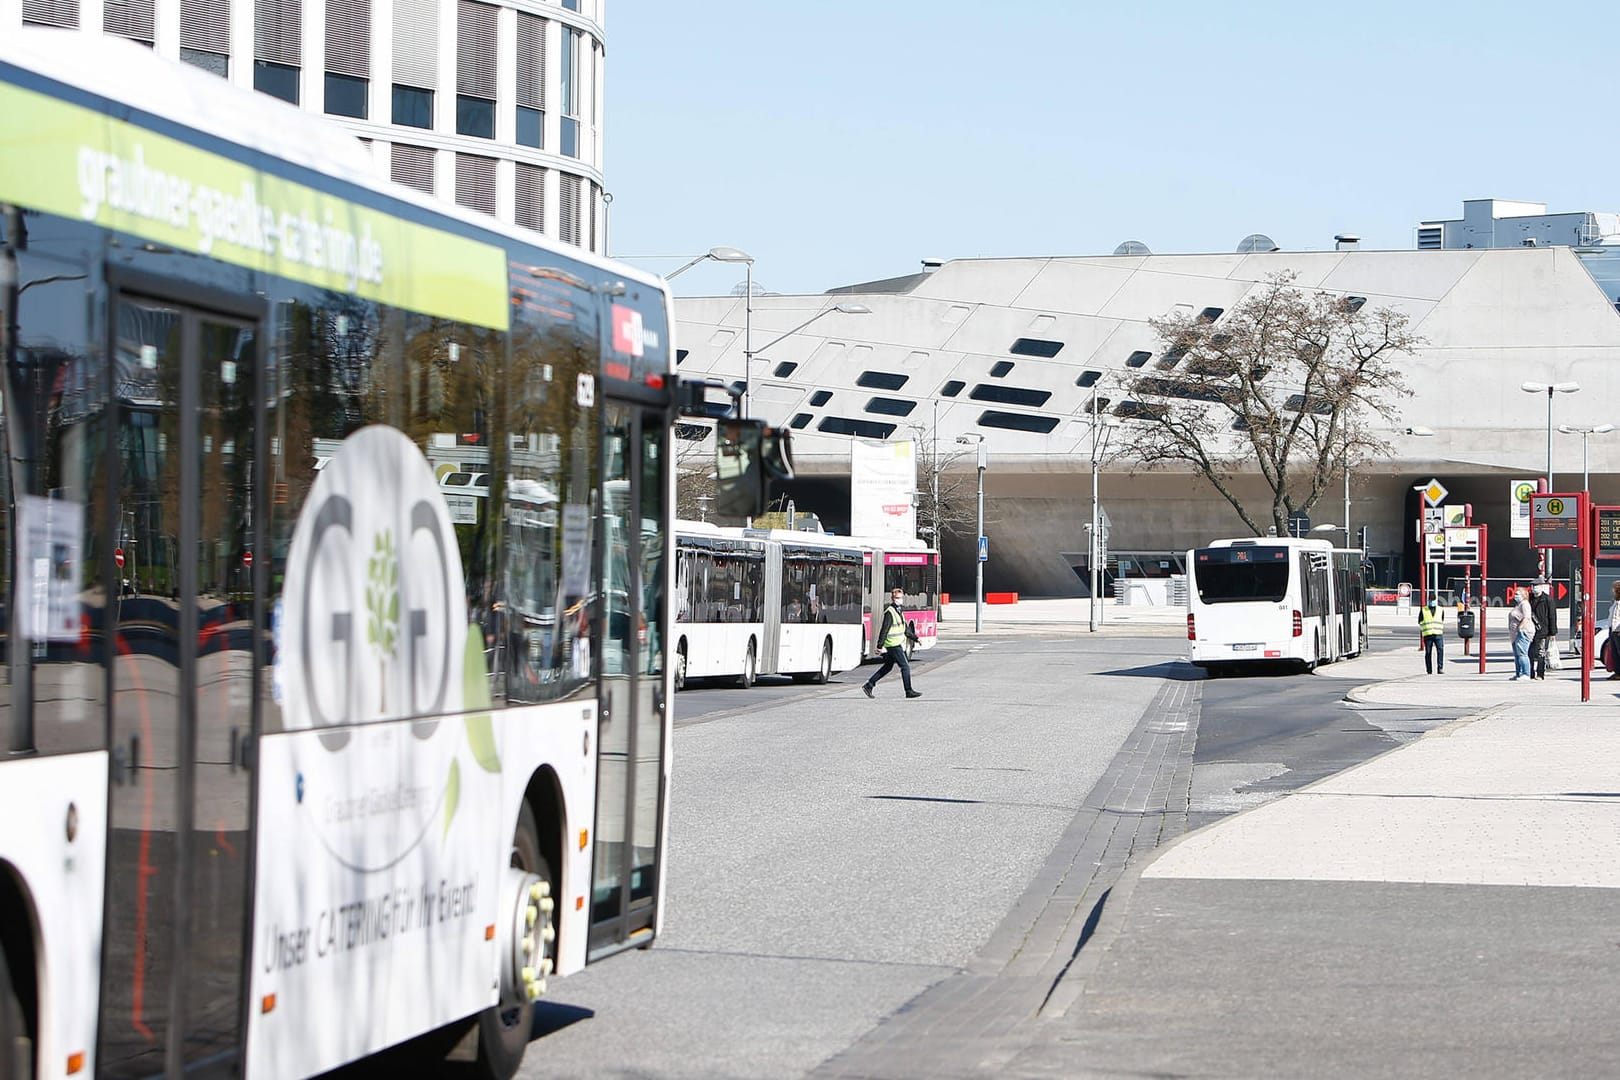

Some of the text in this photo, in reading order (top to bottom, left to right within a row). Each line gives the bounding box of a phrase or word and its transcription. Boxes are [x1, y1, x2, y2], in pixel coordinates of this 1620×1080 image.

[1536, 504, 1542, 512] 2
[265, 922, 310, 974] Unser
[318, 895, 390, 958] CATERING
